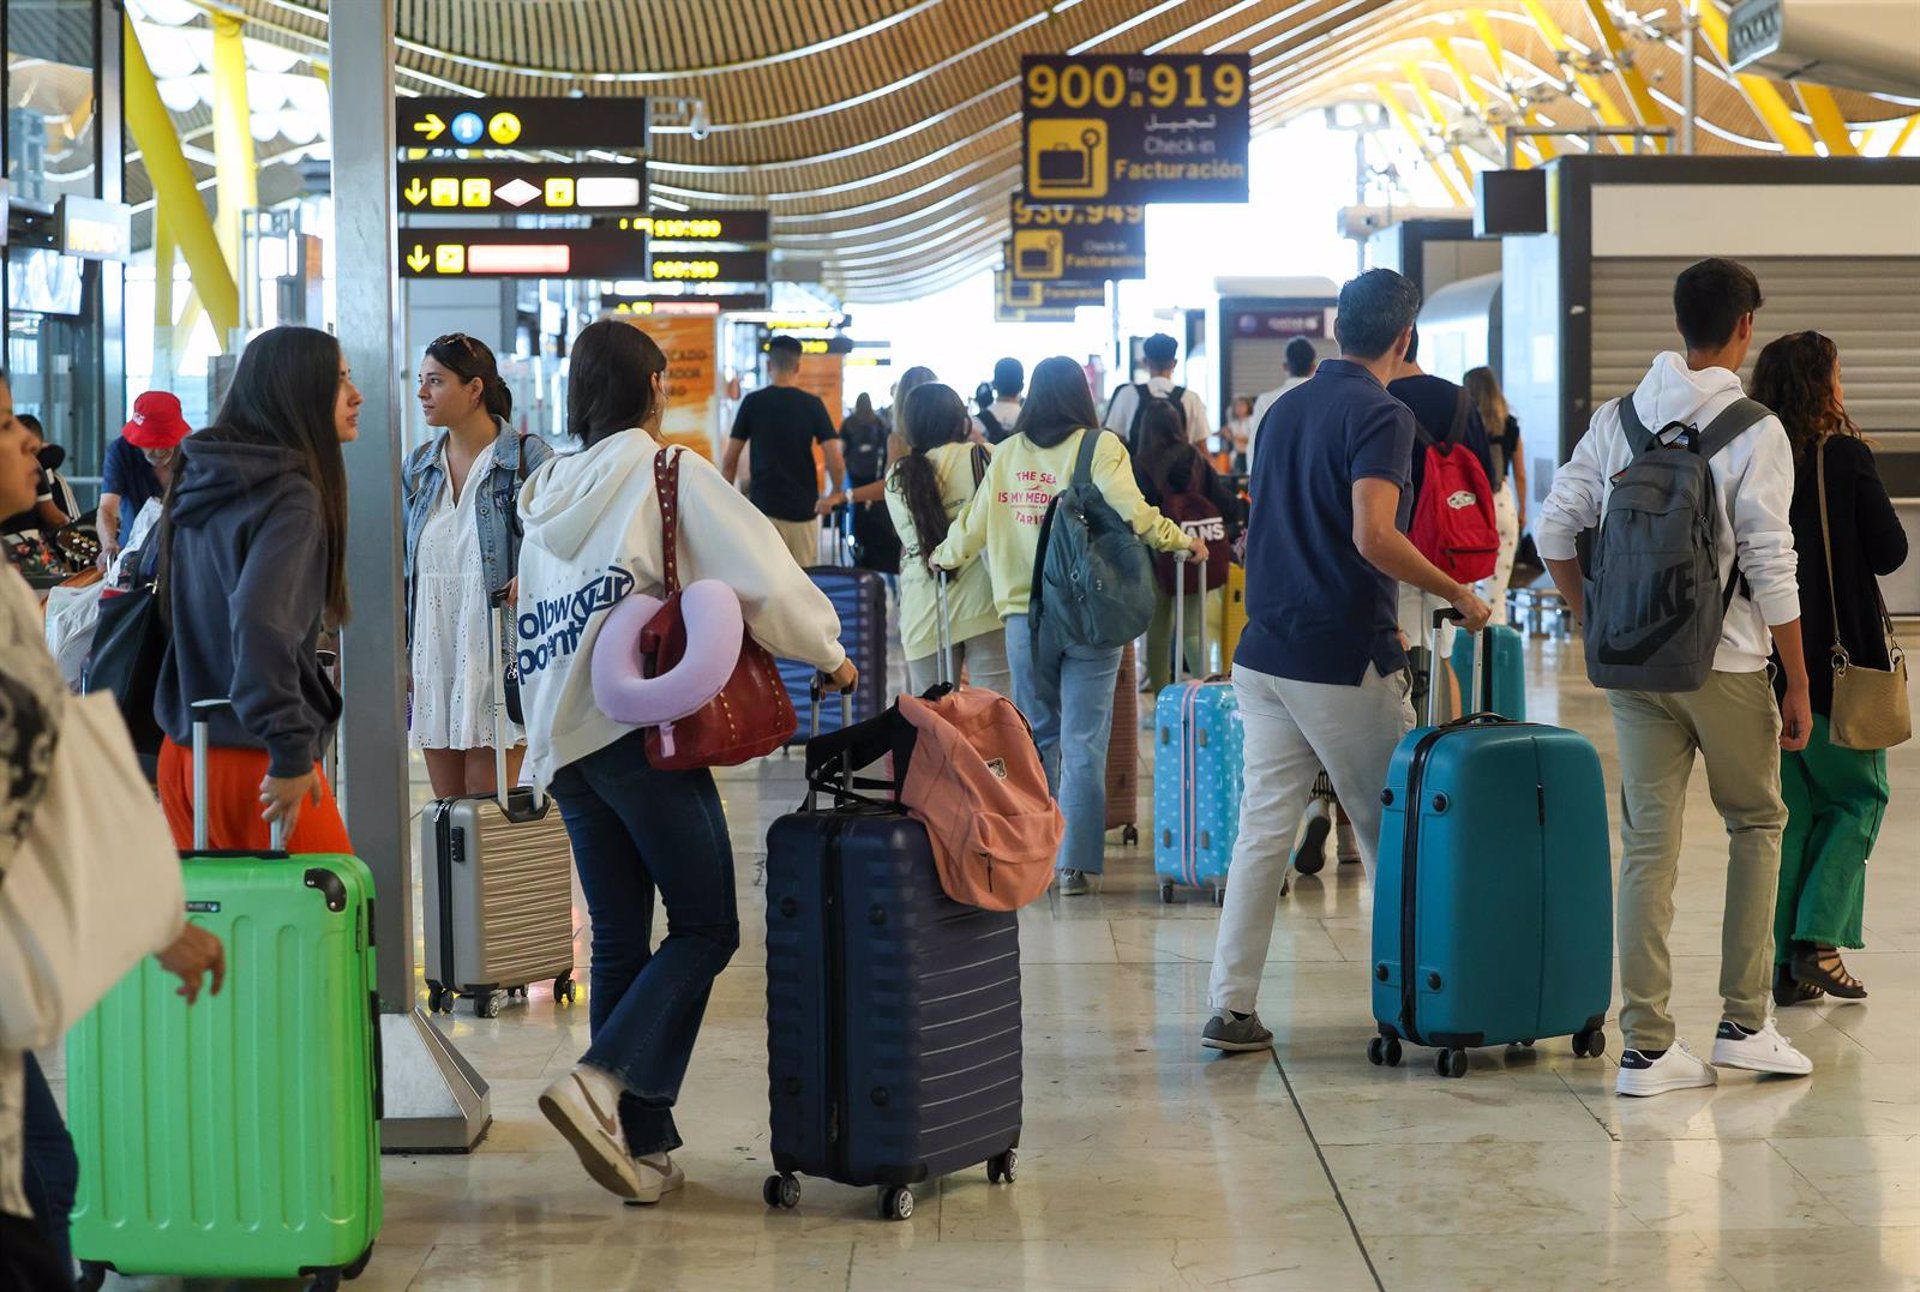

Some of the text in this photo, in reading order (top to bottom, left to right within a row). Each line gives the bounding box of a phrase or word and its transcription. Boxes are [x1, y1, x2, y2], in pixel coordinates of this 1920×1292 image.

[1027, 63, 1244, 109] 900 a 919
[1115, 158, 1243, 180] Facturación
[1016, 471, 1037, 481] THE
[997, 491, 1008, 503] IS
